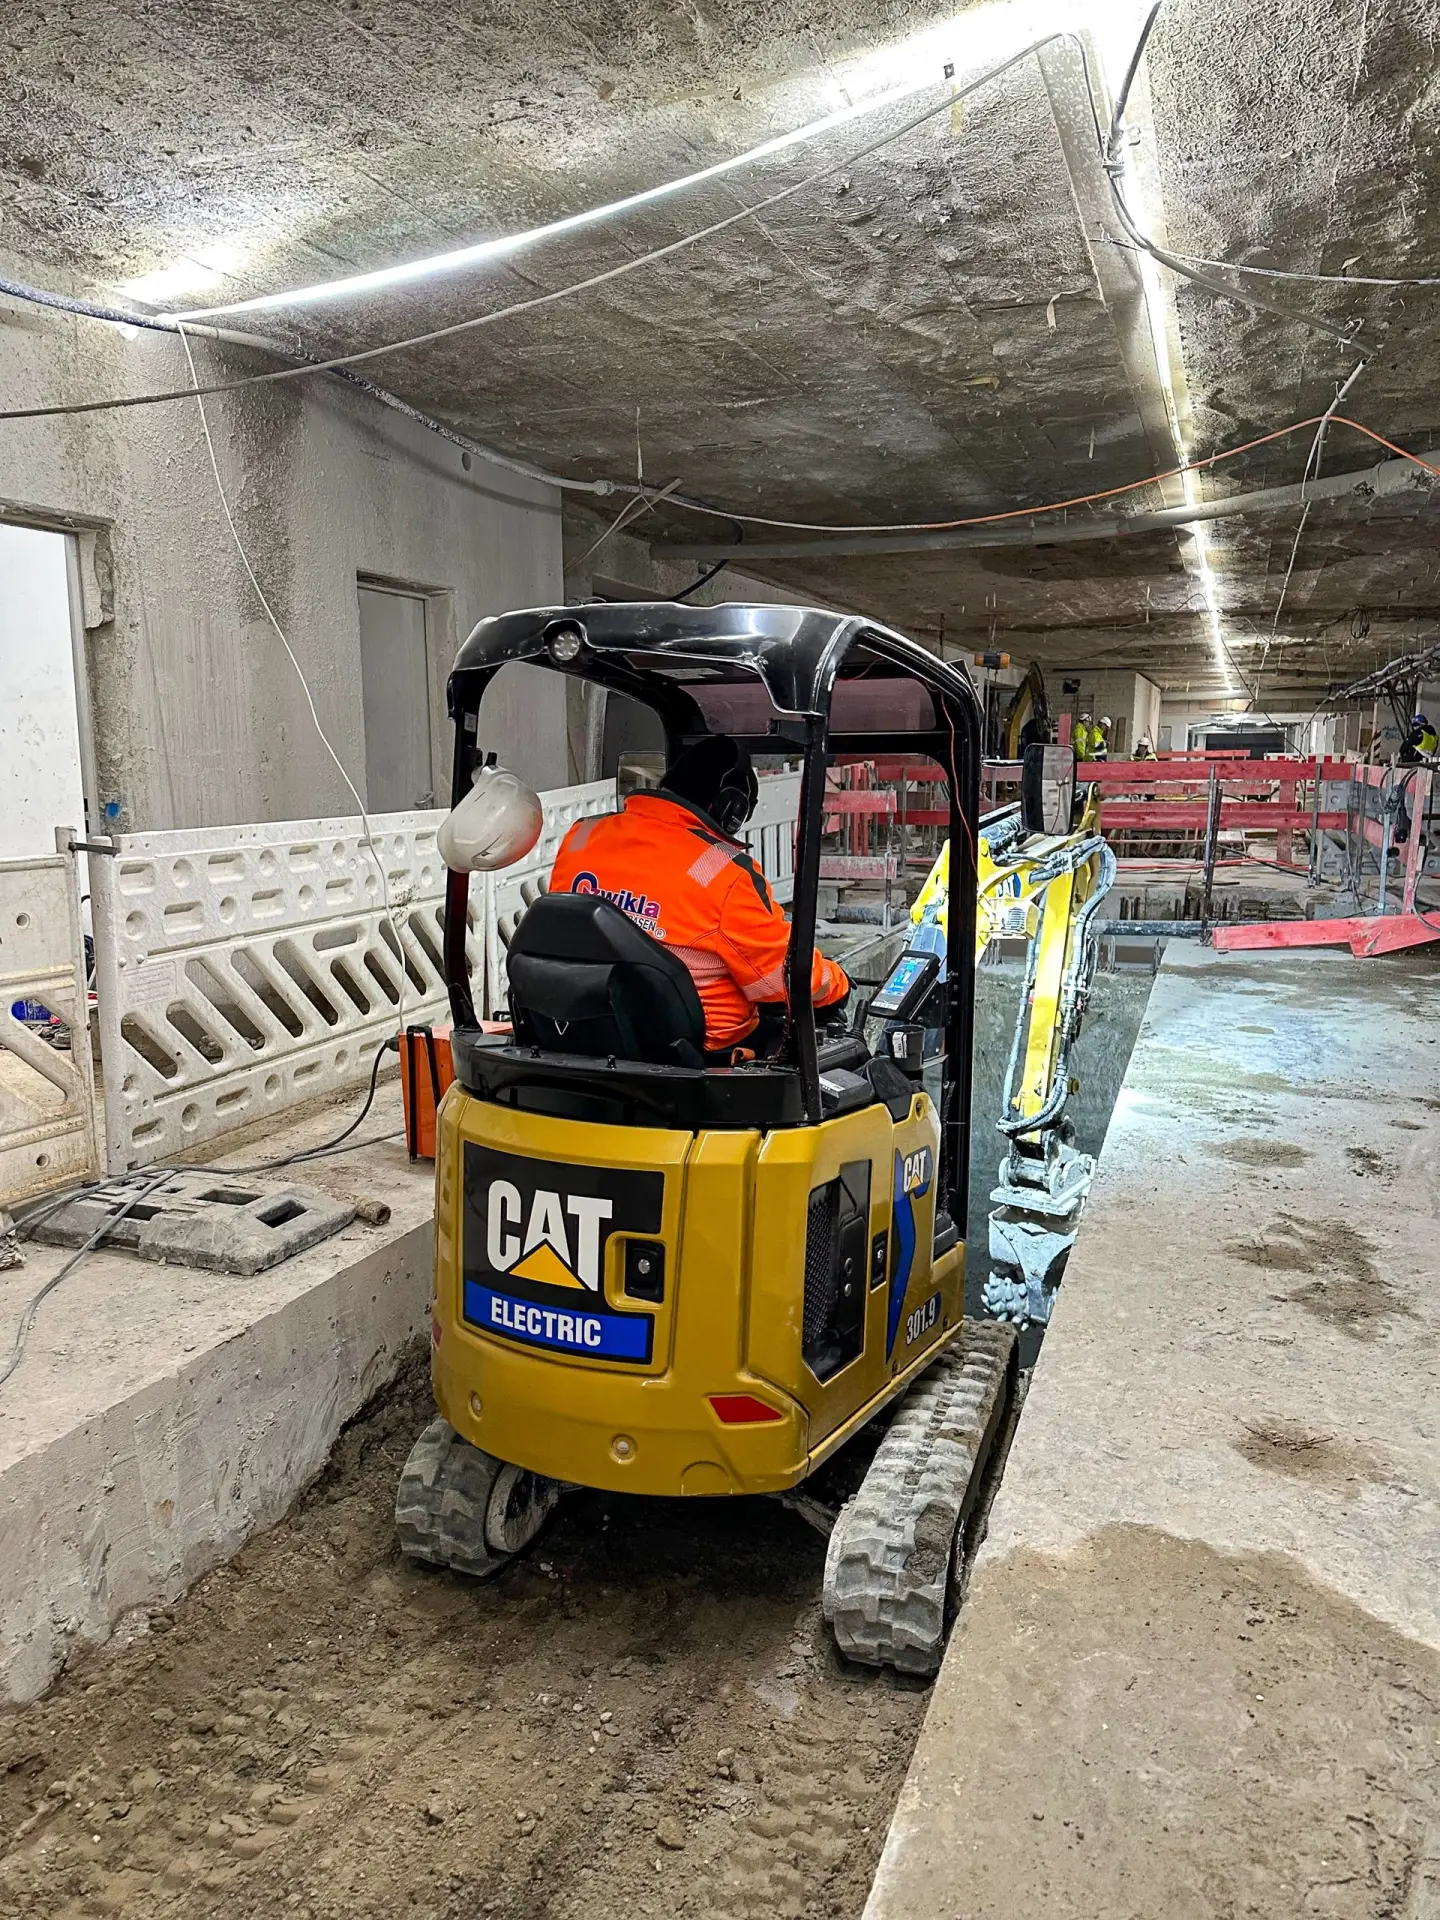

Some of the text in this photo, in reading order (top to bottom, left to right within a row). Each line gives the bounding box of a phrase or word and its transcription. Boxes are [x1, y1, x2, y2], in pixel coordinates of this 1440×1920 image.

[903, 1149, 927, 1193] CAT
[487, 1179, 613, 1292] CAT
[491, 1296, 602, 1347] ELECTRIC
[906, 1296, 936, 1346] 301.9
